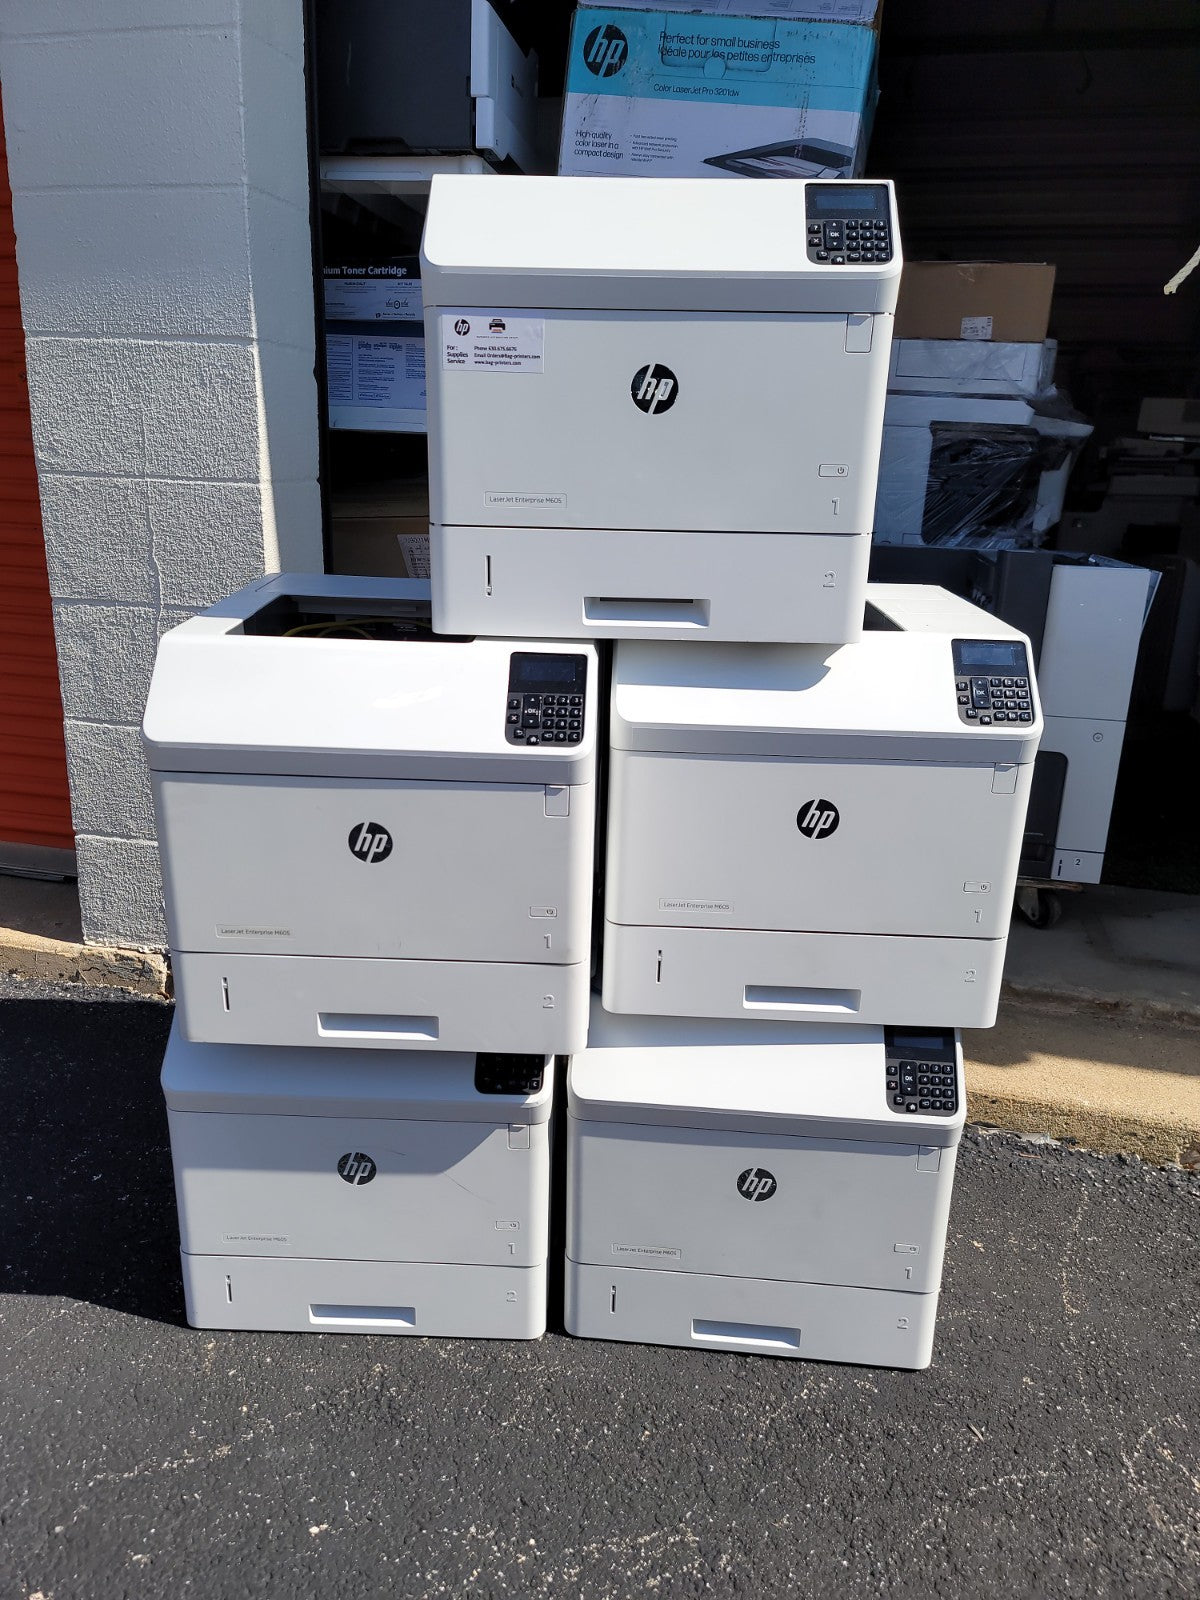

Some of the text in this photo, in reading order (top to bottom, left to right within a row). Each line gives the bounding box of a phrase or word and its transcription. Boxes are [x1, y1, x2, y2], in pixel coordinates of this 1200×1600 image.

[660, 31, 780, 50] Perfect for small business
[588, 25, 625, 77] hp
[688, 49, 710, 60] pour
[727, 50, 760, 61] petites
[761, 52, 816, 64] entreprises
[654, 84, 671, 92] Color
[672, 86, 702, 94] LaserJet
[702, 87, 714, 95] Pro
[576, 130, 612, 140] High quality
[592, 140, 607, 148] laser
[574, 149, 602, 158] compact
[602, 150, 624, 160] design
[324, 266, 408, 276] ium Toner Cartridge
[456, 319, 470, 336] hp
[636, 363, 675, 415] hp
[515, 496, 544, 504] Enterprise
[832, 497, 840, 516] 1
[822, 570, 836, 588] 2
[800, 799, 836, 840] hp
[353, 822, 389, 863] hp
[974, 909, 982, 923] 1
[544, 934, 552, 949] 1
[964, 968, 976, 982] 2
[542, 994, 554, 1008] 2
[342, 1152, 372, 1185] hp
[741, 1168, 773, 1201] hp
[508, 1242, 516, 1254] 1
[904, 1266, 913, 1280] 1
[896, 1316, 909, 1330] 2
